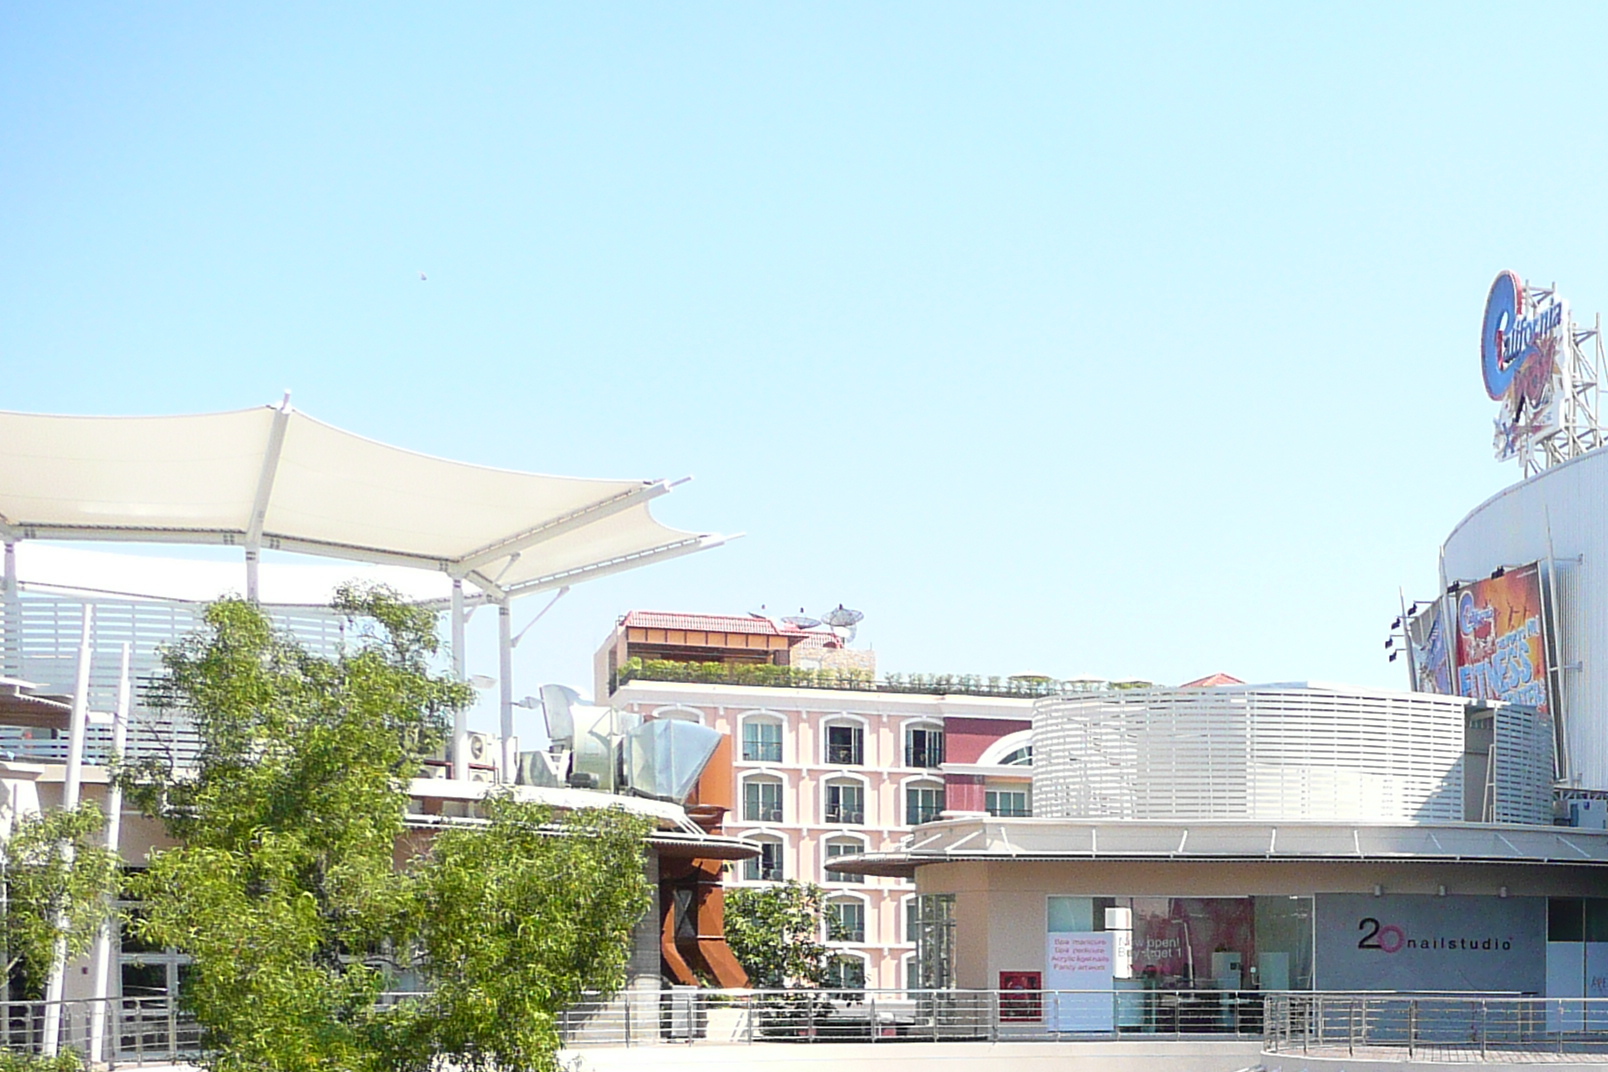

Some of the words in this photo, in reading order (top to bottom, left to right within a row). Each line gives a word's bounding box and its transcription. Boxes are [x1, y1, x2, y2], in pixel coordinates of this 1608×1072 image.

[1481, 270, 1563, 401] California
[1458, 640, 1533, 700] FITNESS
[1358, 917, 1404, 954] 20
[1407, 937, 1511, 951] nailstudio
